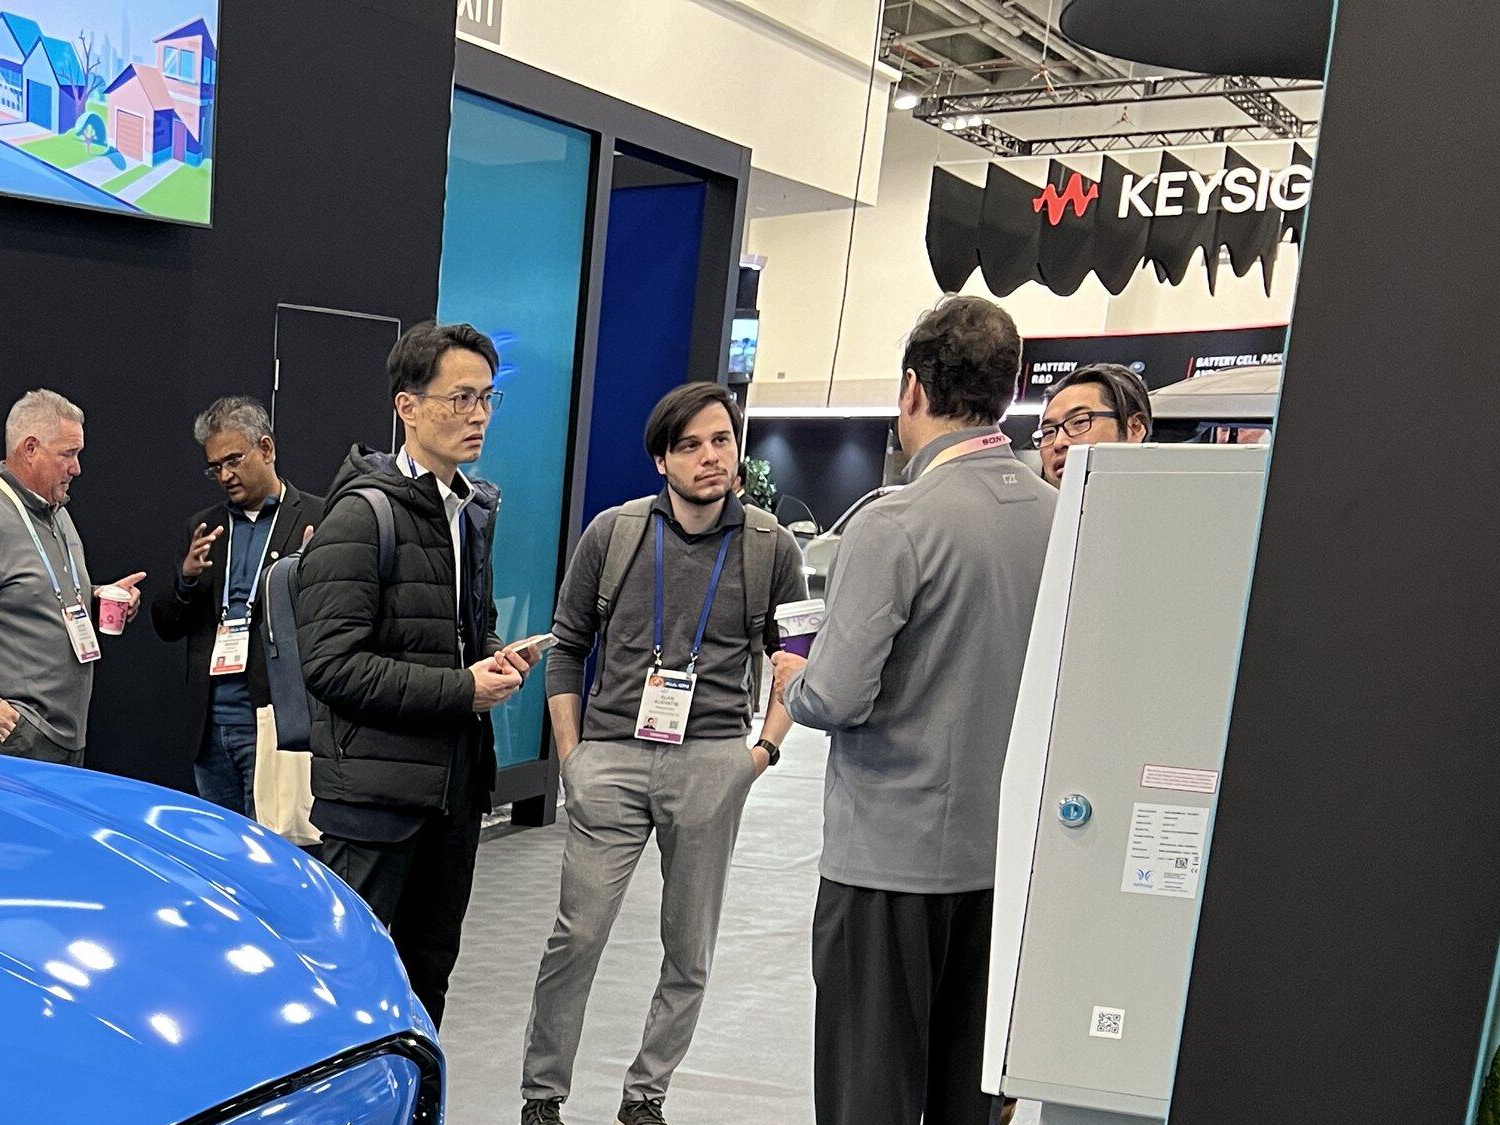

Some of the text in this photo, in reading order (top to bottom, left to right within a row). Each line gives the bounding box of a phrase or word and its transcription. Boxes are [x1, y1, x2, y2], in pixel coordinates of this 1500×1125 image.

[1033, 361, 1078, 372] BATTERY
[1196, 355, 1237, 367] BATTERY
[1031, 373, 1053, 384] R&D
